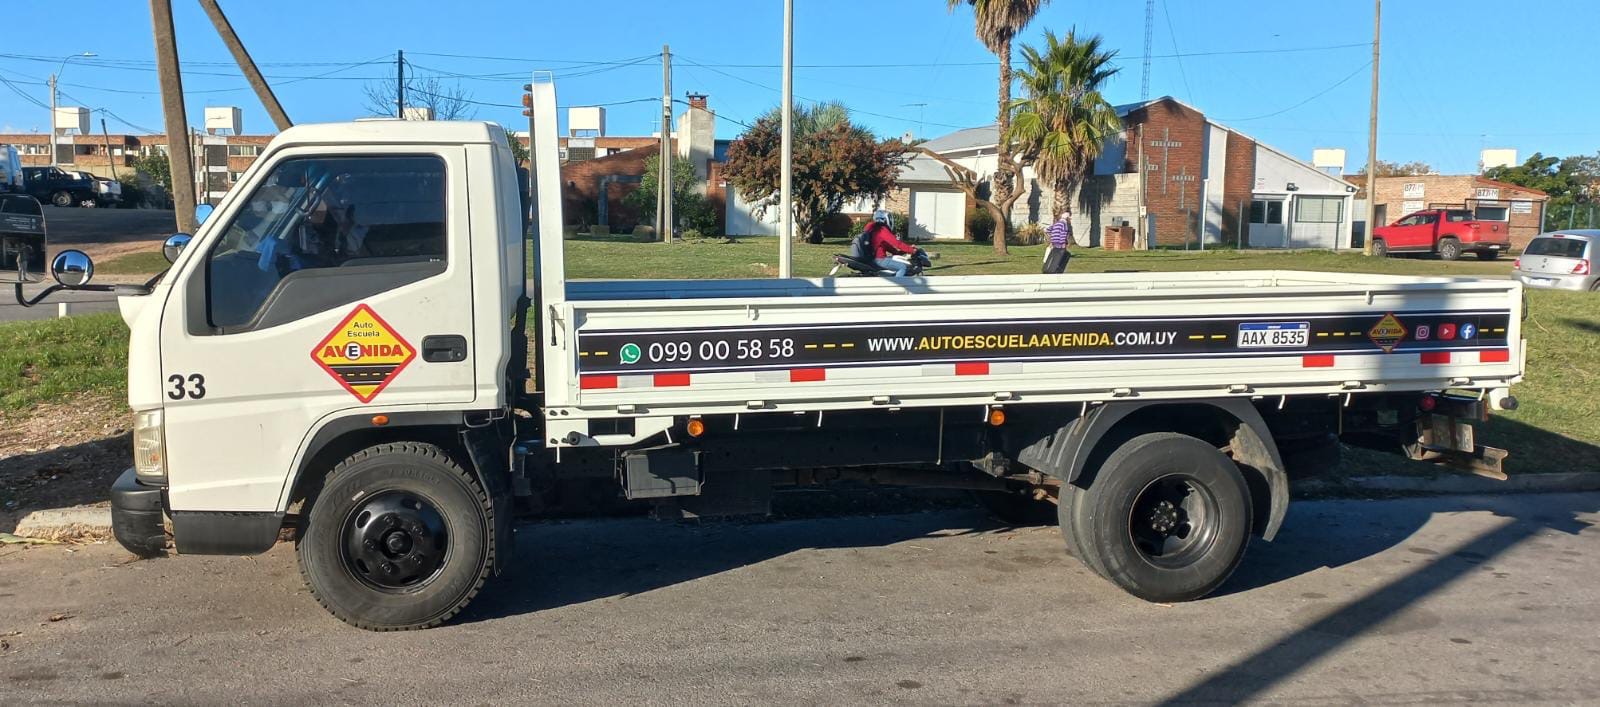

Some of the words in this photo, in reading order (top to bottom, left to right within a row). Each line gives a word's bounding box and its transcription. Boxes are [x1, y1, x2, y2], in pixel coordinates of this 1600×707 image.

[347, 330, 380, 338] Escuela
[867, 331, 1178, 352] WWW.AUTOESCUELAAVENIDA.COM.UY
[1241, 331, 1267, 345] AAX
[1272, 330, 1306, 345] 8535
[323, 343, 404, 358] AVENIDA
[649, 342, 692, 362] 099
[699, 340, 730, 360] 00
[737, 339, 763, 359] 58
[769, 338, 795, 358] 58
[167, 373, 206, 400] 33
